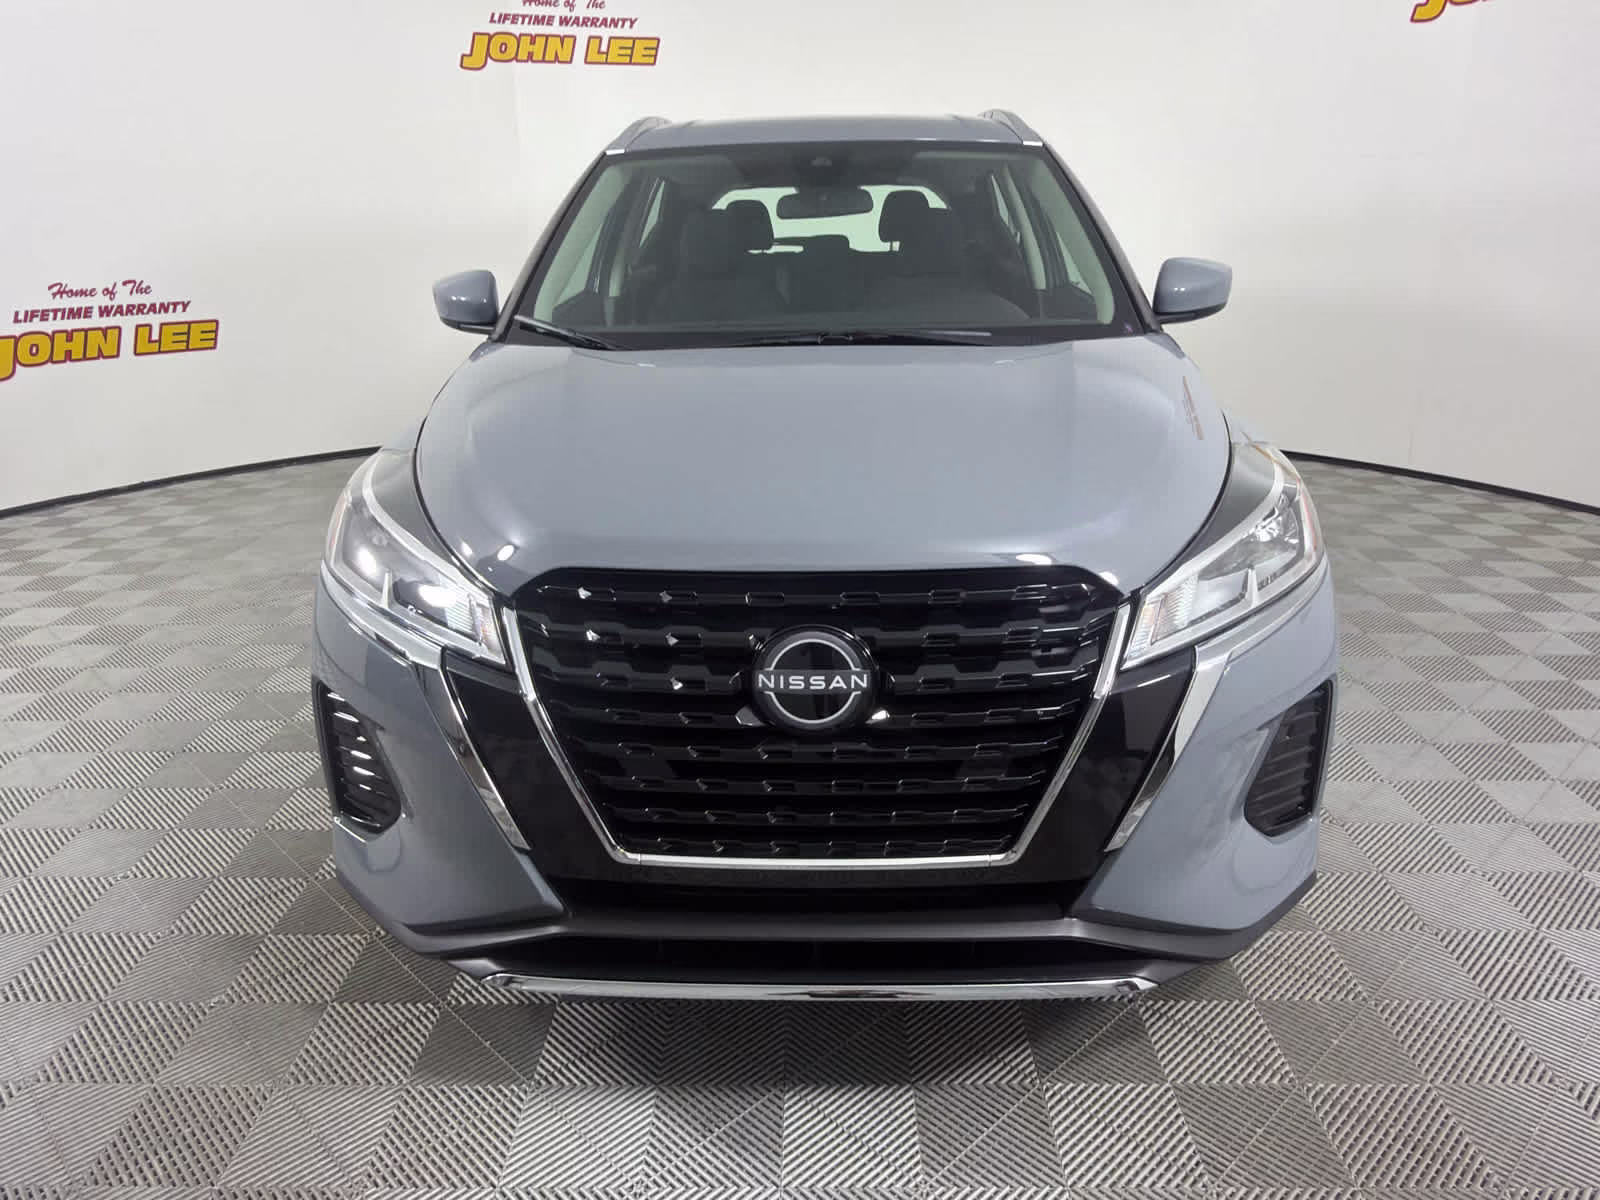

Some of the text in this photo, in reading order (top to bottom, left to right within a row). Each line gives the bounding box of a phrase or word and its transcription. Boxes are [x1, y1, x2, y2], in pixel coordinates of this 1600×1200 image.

[563, 0, 576, 13] of
[489, 12, 638, 29] LIFETIME WARRANTY
[460, 32, 660, 71] JOHN LEE
[47, 279, 152, 300] Home of The
[13, 301, 191, 324] LIFETIME WARRANTY
[134, 319, 219, 356] LEE
[758, 673, 868, 690] NISSAN
